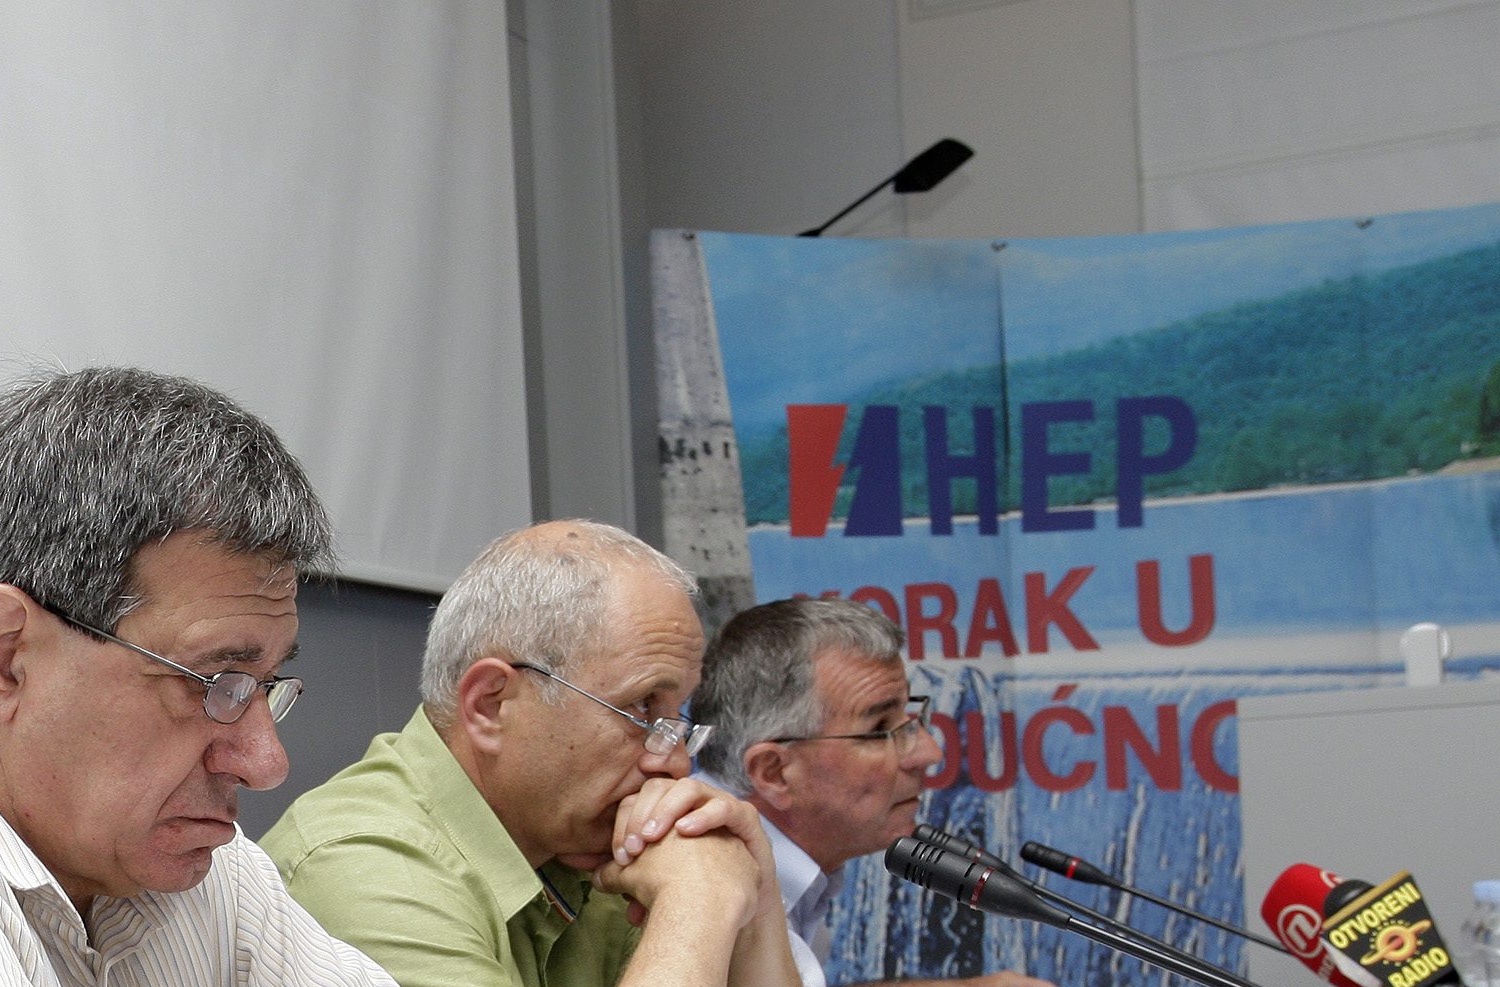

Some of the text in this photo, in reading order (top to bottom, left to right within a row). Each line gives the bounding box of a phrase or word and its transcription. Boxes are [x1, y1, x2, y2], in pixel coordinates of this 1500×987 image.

[923, 395, 1198, 536] HEP
[1136, 553, 1217, 648] U
[1328, 881, 1422, 949] OTVORENI
